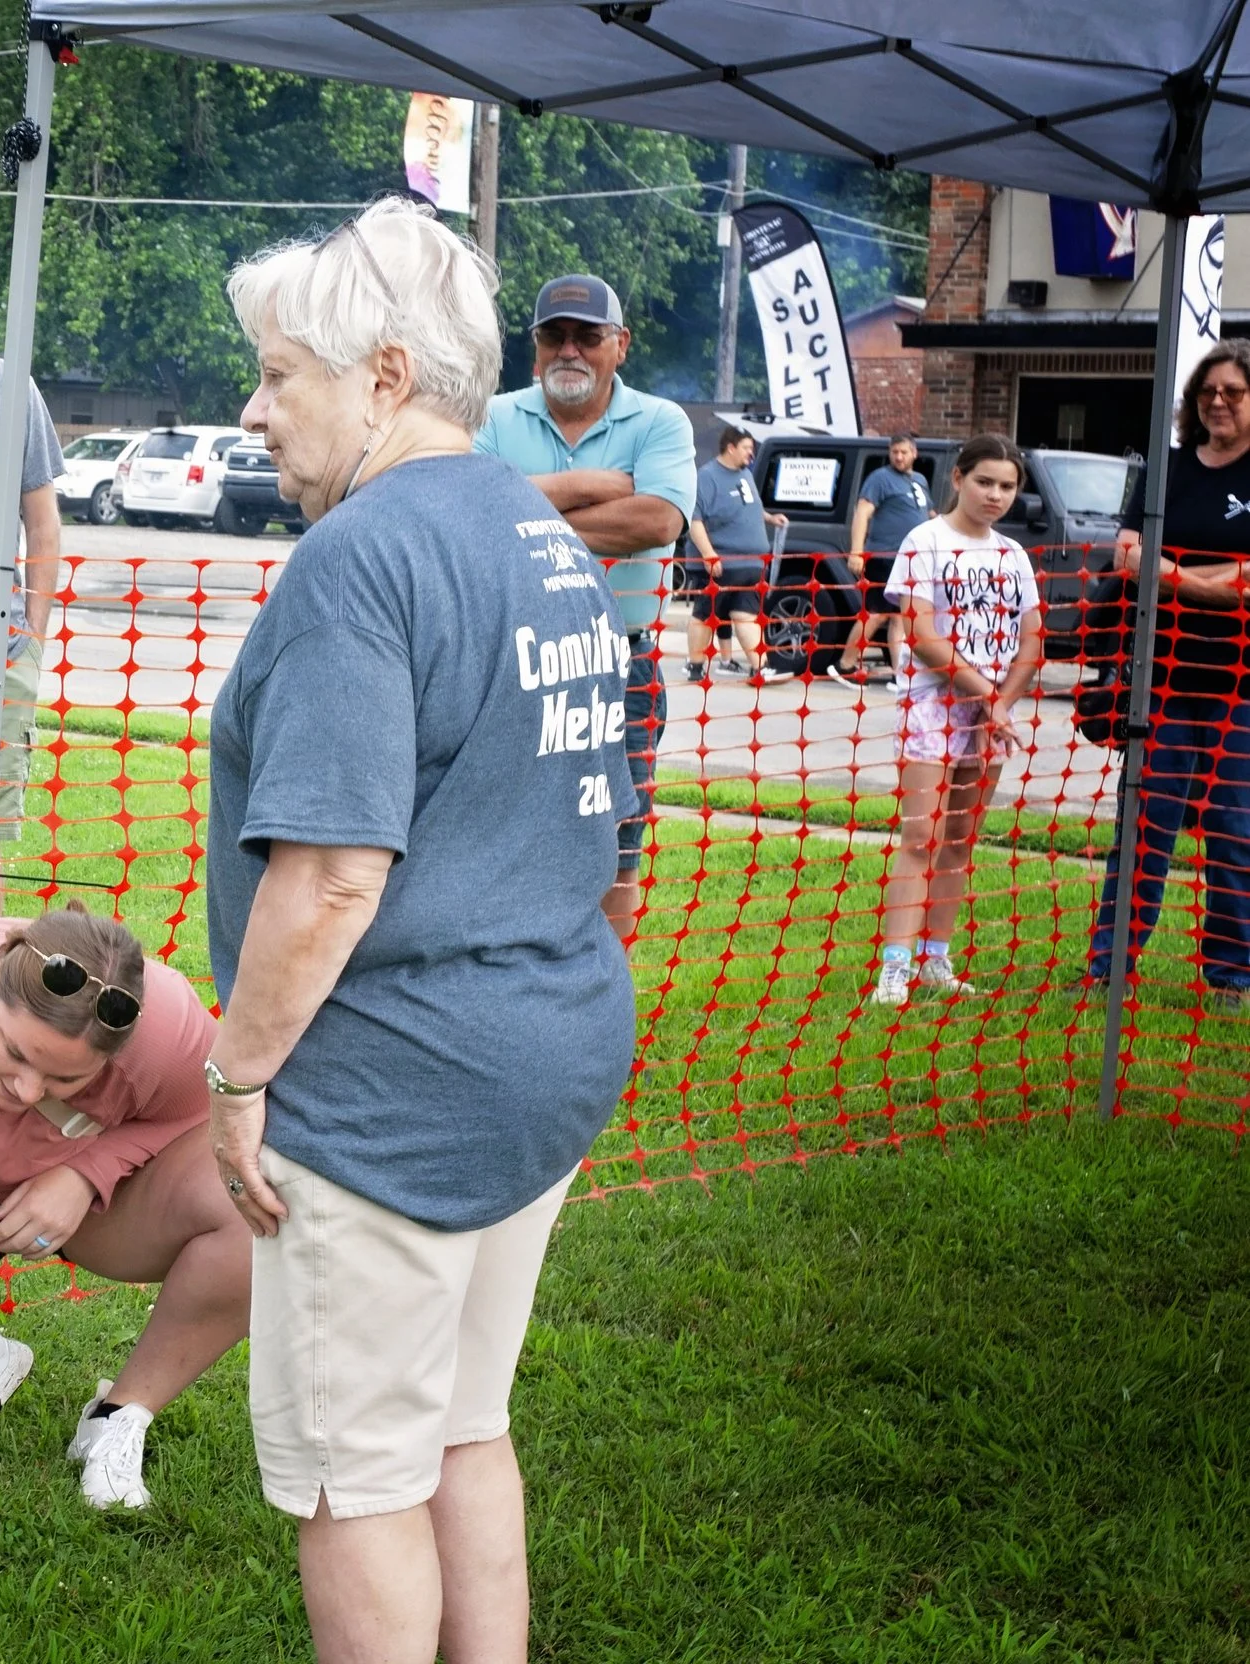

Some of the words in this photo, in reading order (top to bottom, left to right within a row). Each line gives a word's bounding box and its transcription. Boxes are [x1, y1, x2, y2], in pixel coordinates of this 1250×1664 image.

[425, 96, 448, 187] elcome
[772, 298, 805, 419] SILE
[793, 268, 834, 427] AUCTI
